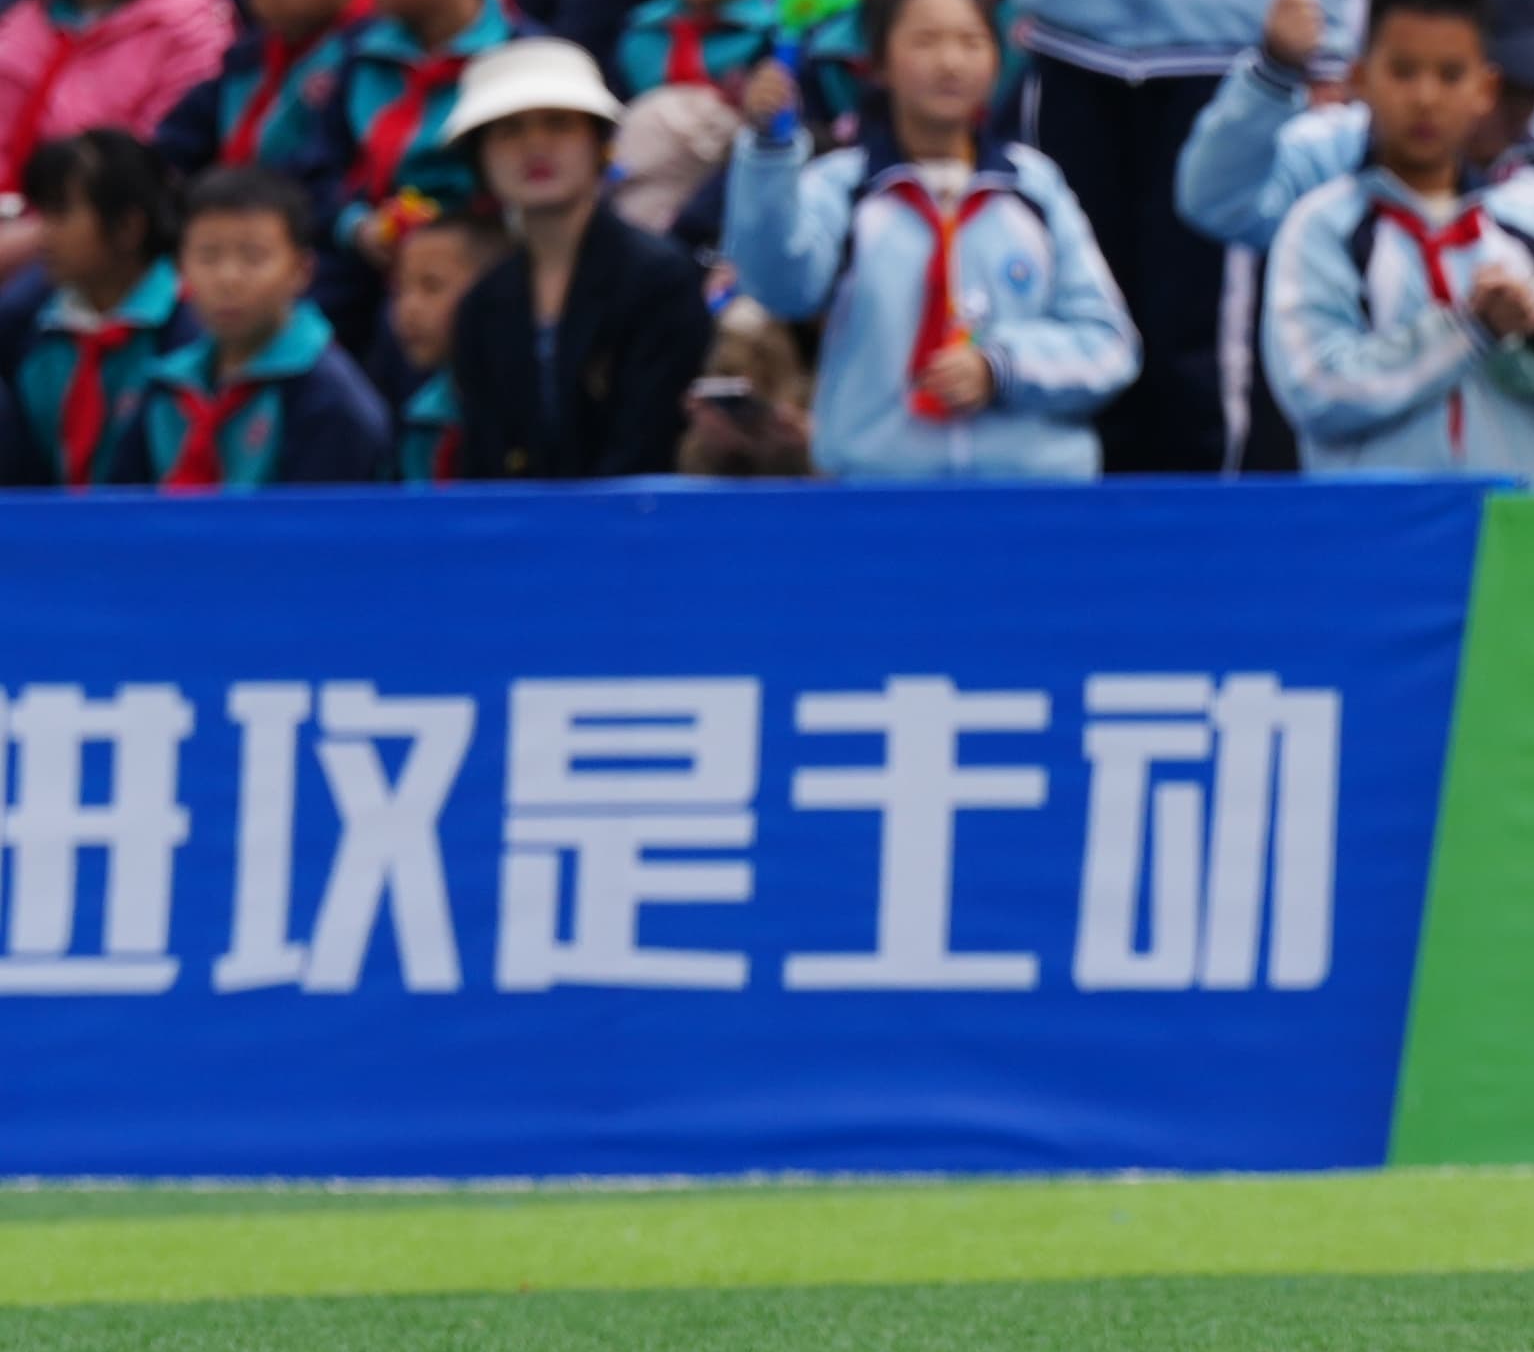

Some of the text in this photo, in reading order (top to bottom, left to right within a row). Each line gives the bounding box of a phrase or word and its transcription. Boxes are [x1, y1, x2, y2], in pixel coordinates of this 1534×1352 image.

[0, 674, 1341, 994] 进攻是主动
